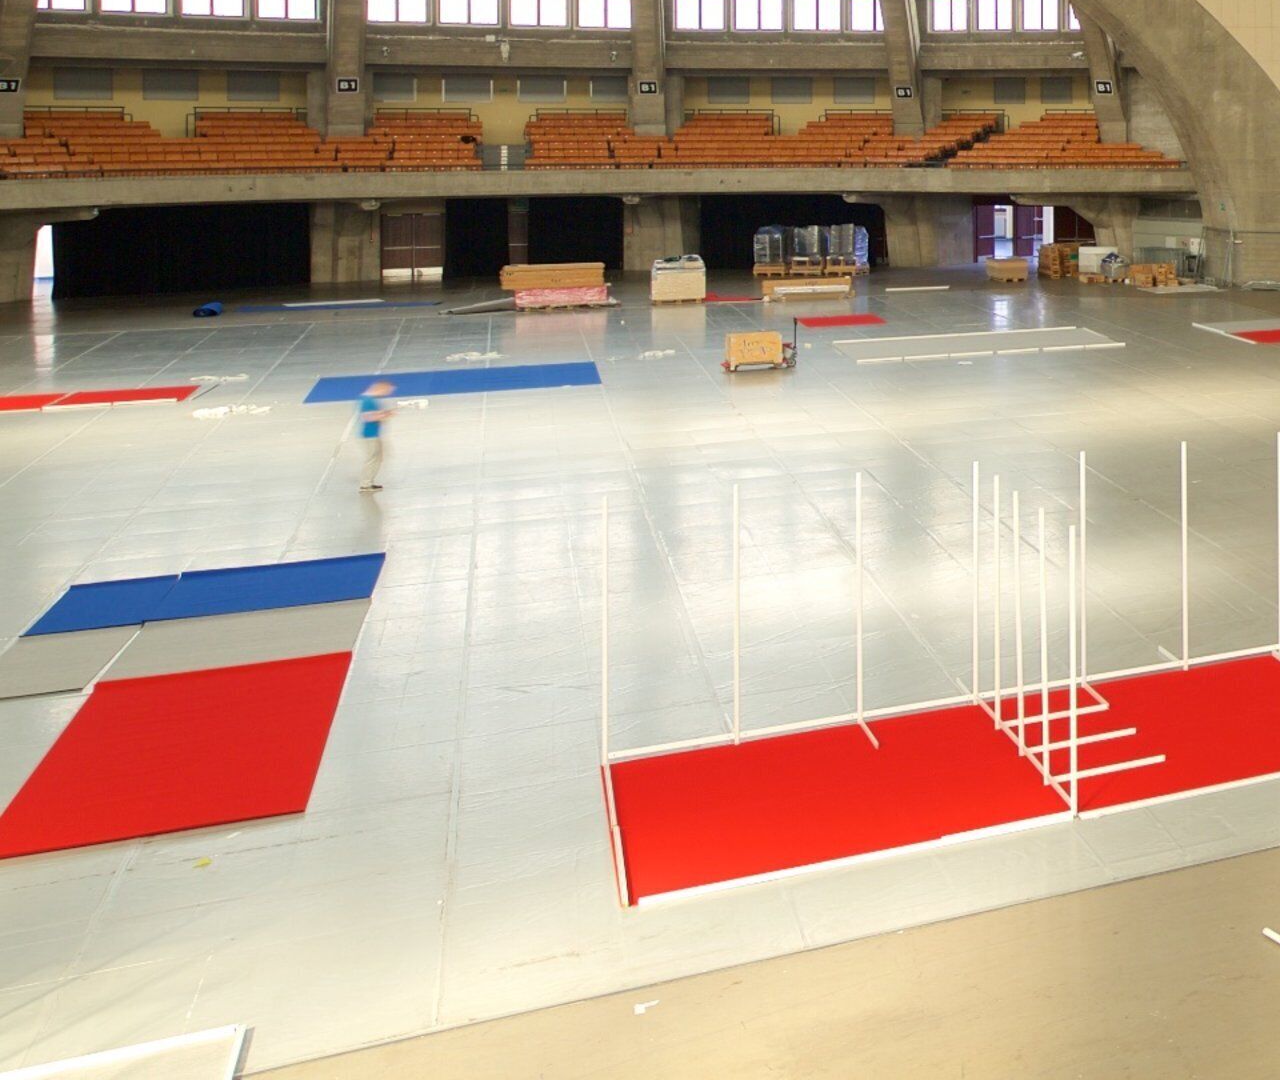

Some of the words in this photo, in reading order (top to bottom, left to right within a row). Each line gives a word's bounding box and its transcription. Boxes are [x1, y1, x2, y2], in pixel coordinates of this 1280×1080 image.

[340, 81, 355, 89] B1
[641, 84, 655, 92] B1
[1098, 83, 1110, 92] B1
[898, 88, 911, 96] B1
